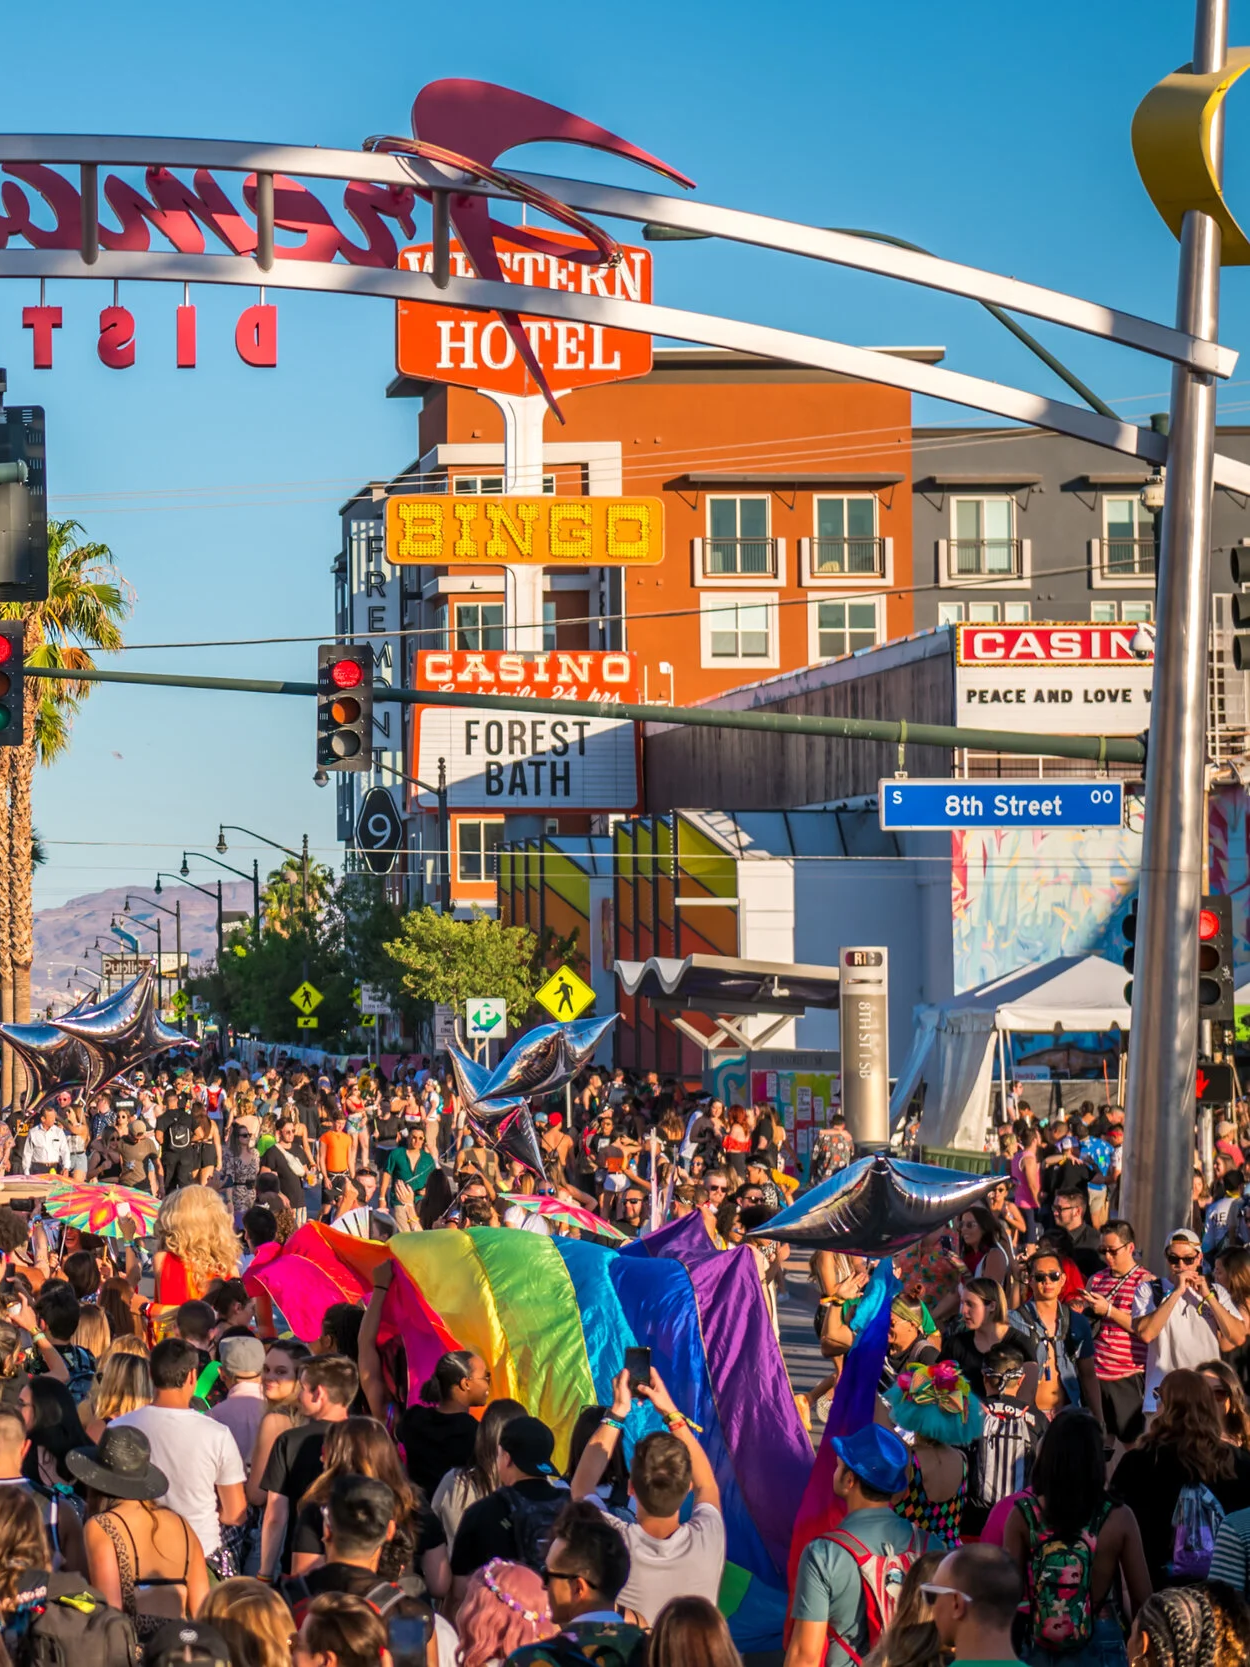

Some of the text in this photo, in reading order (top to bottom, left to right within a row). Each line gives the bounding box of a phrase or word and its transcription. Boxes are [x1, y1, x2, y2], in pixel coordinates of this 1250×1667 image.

[436, 321, 621, 370] HOTEL
[398, 503, 651, 558] BINGO
[366, 535, 393, 774] FREMNT
[973, 631, 1154, 659] CASIN
[425, 654, 631, 683] CASINO
[966, 689, 1026, 704] PEACE
[1034, 689, 1073, 704] AND
[1083, 689, 1132, 703] LOVE
[465, 720, 590, 757] FOREST
[485, 761, 570, 797] BATH
[892, 790, 1113, 816] S 8th Street 00
[368, 814, 391, 849] 9
[480, 1006, 496, 1025] P
[858, 1001, 872, 1029] 8TH
[859, 1033, 871, 1048] ST
